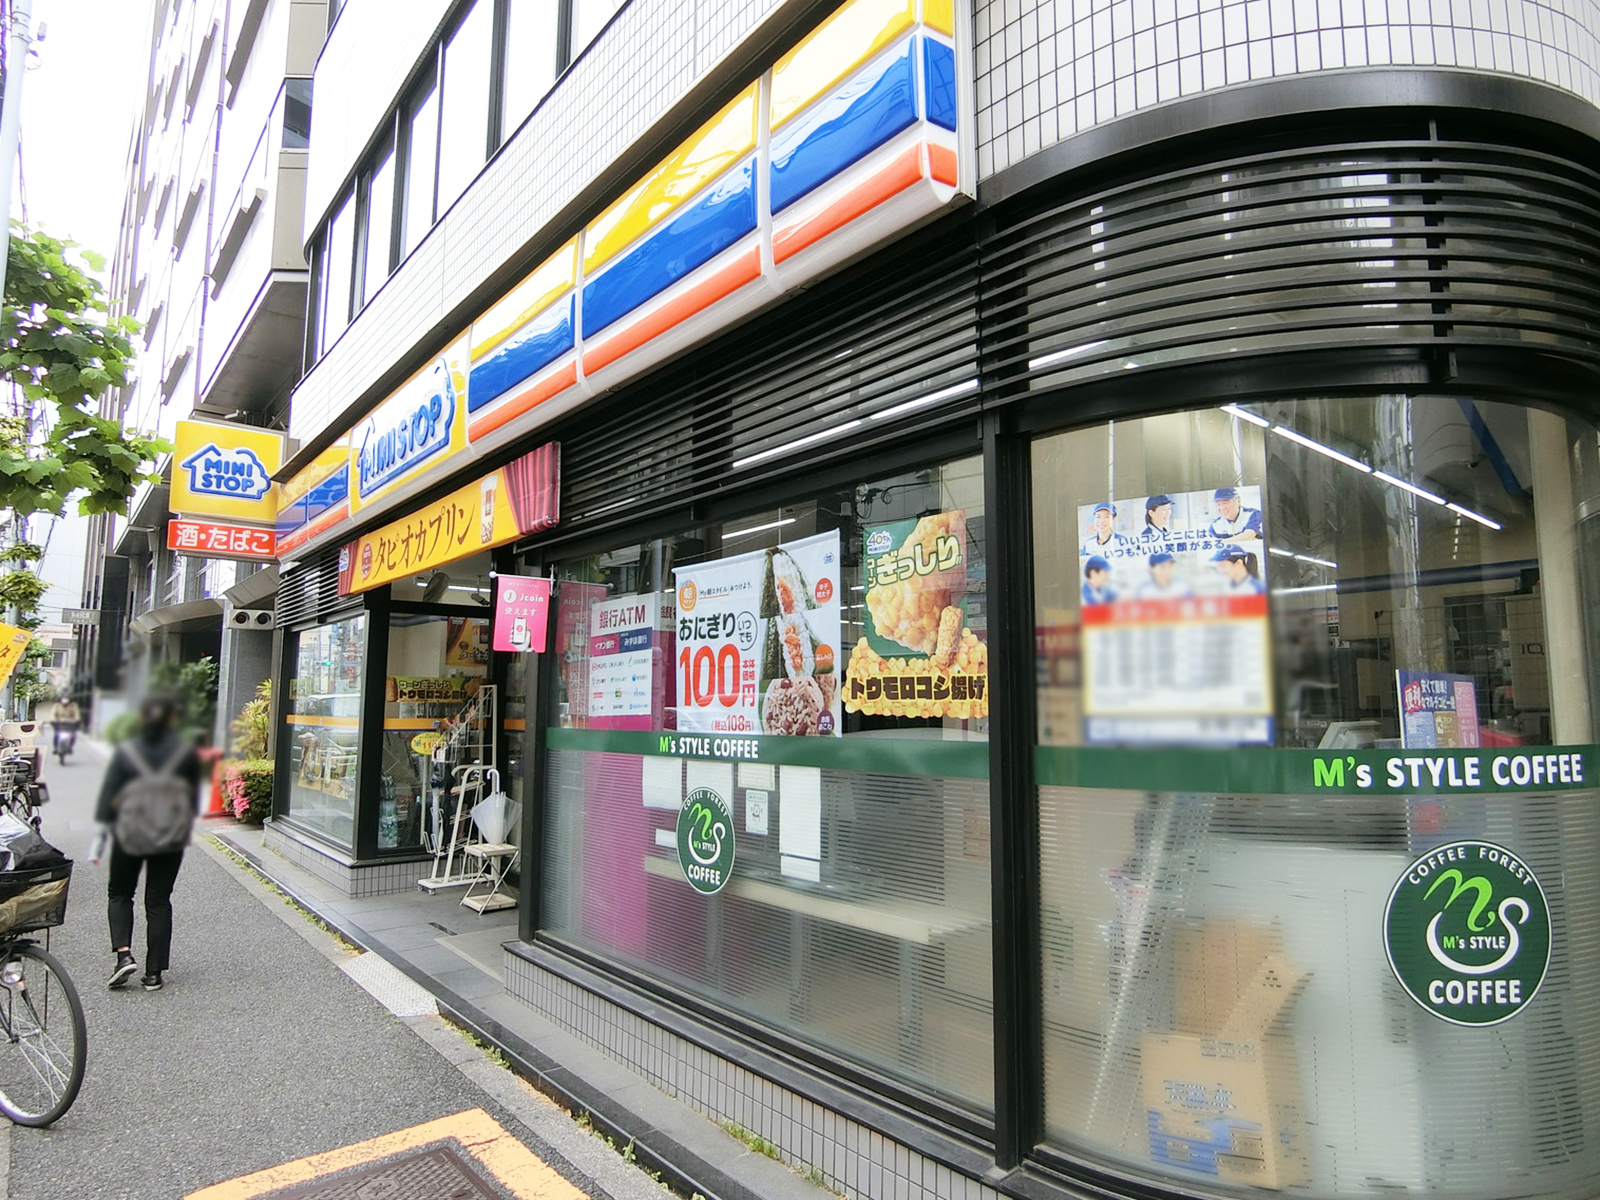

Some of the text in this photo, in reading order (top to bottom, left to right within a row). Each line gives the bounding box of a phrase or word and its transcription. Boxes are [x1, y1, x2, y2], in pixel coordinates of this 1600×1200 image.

[397, 394, 442, 460] STOP
[203, 457, 253, 477] MINI
[201, 474, 254, 492] STOP
[175, 525, 270, 553] 酒・たばこ
[372, 502, 476, 579] タピオカプリン
[1104, 540, 1232, 559] いつも、いい笑顔がある。
[1119, 529, 1213, 547] いいコンビニには、
[867, 558, 877, 588] コーン
[520, 593, 544, 602] Jcoin
[504, 606, 537, 616] 使えます
[599, 604, 646, 629] 銀行ATM
[679, 612, 736, 641] おにぎり
[738, 619, 752, 631] いつ
[739, 631, 753, 643] でも
[679, 643, 741, 708] 100
[742, 684, 756, 707] 円
[850, 675, 986, 701] トウモロコシ揚げ
[659, 736, 759, 759] M's STYLE COFFEE
[1313, 754, 1582, 788] M's STYLE COFFEE
[684, 790, 728, 817] COFFEE FOREST
[688, 863, 721, 886] COFFEE
[1408, 847, 1532, 886] COFFEE FOREST
[1443, 936, 1506, 949] M's STYLE
[1428, 979, 1521, 1004] COFFEE
